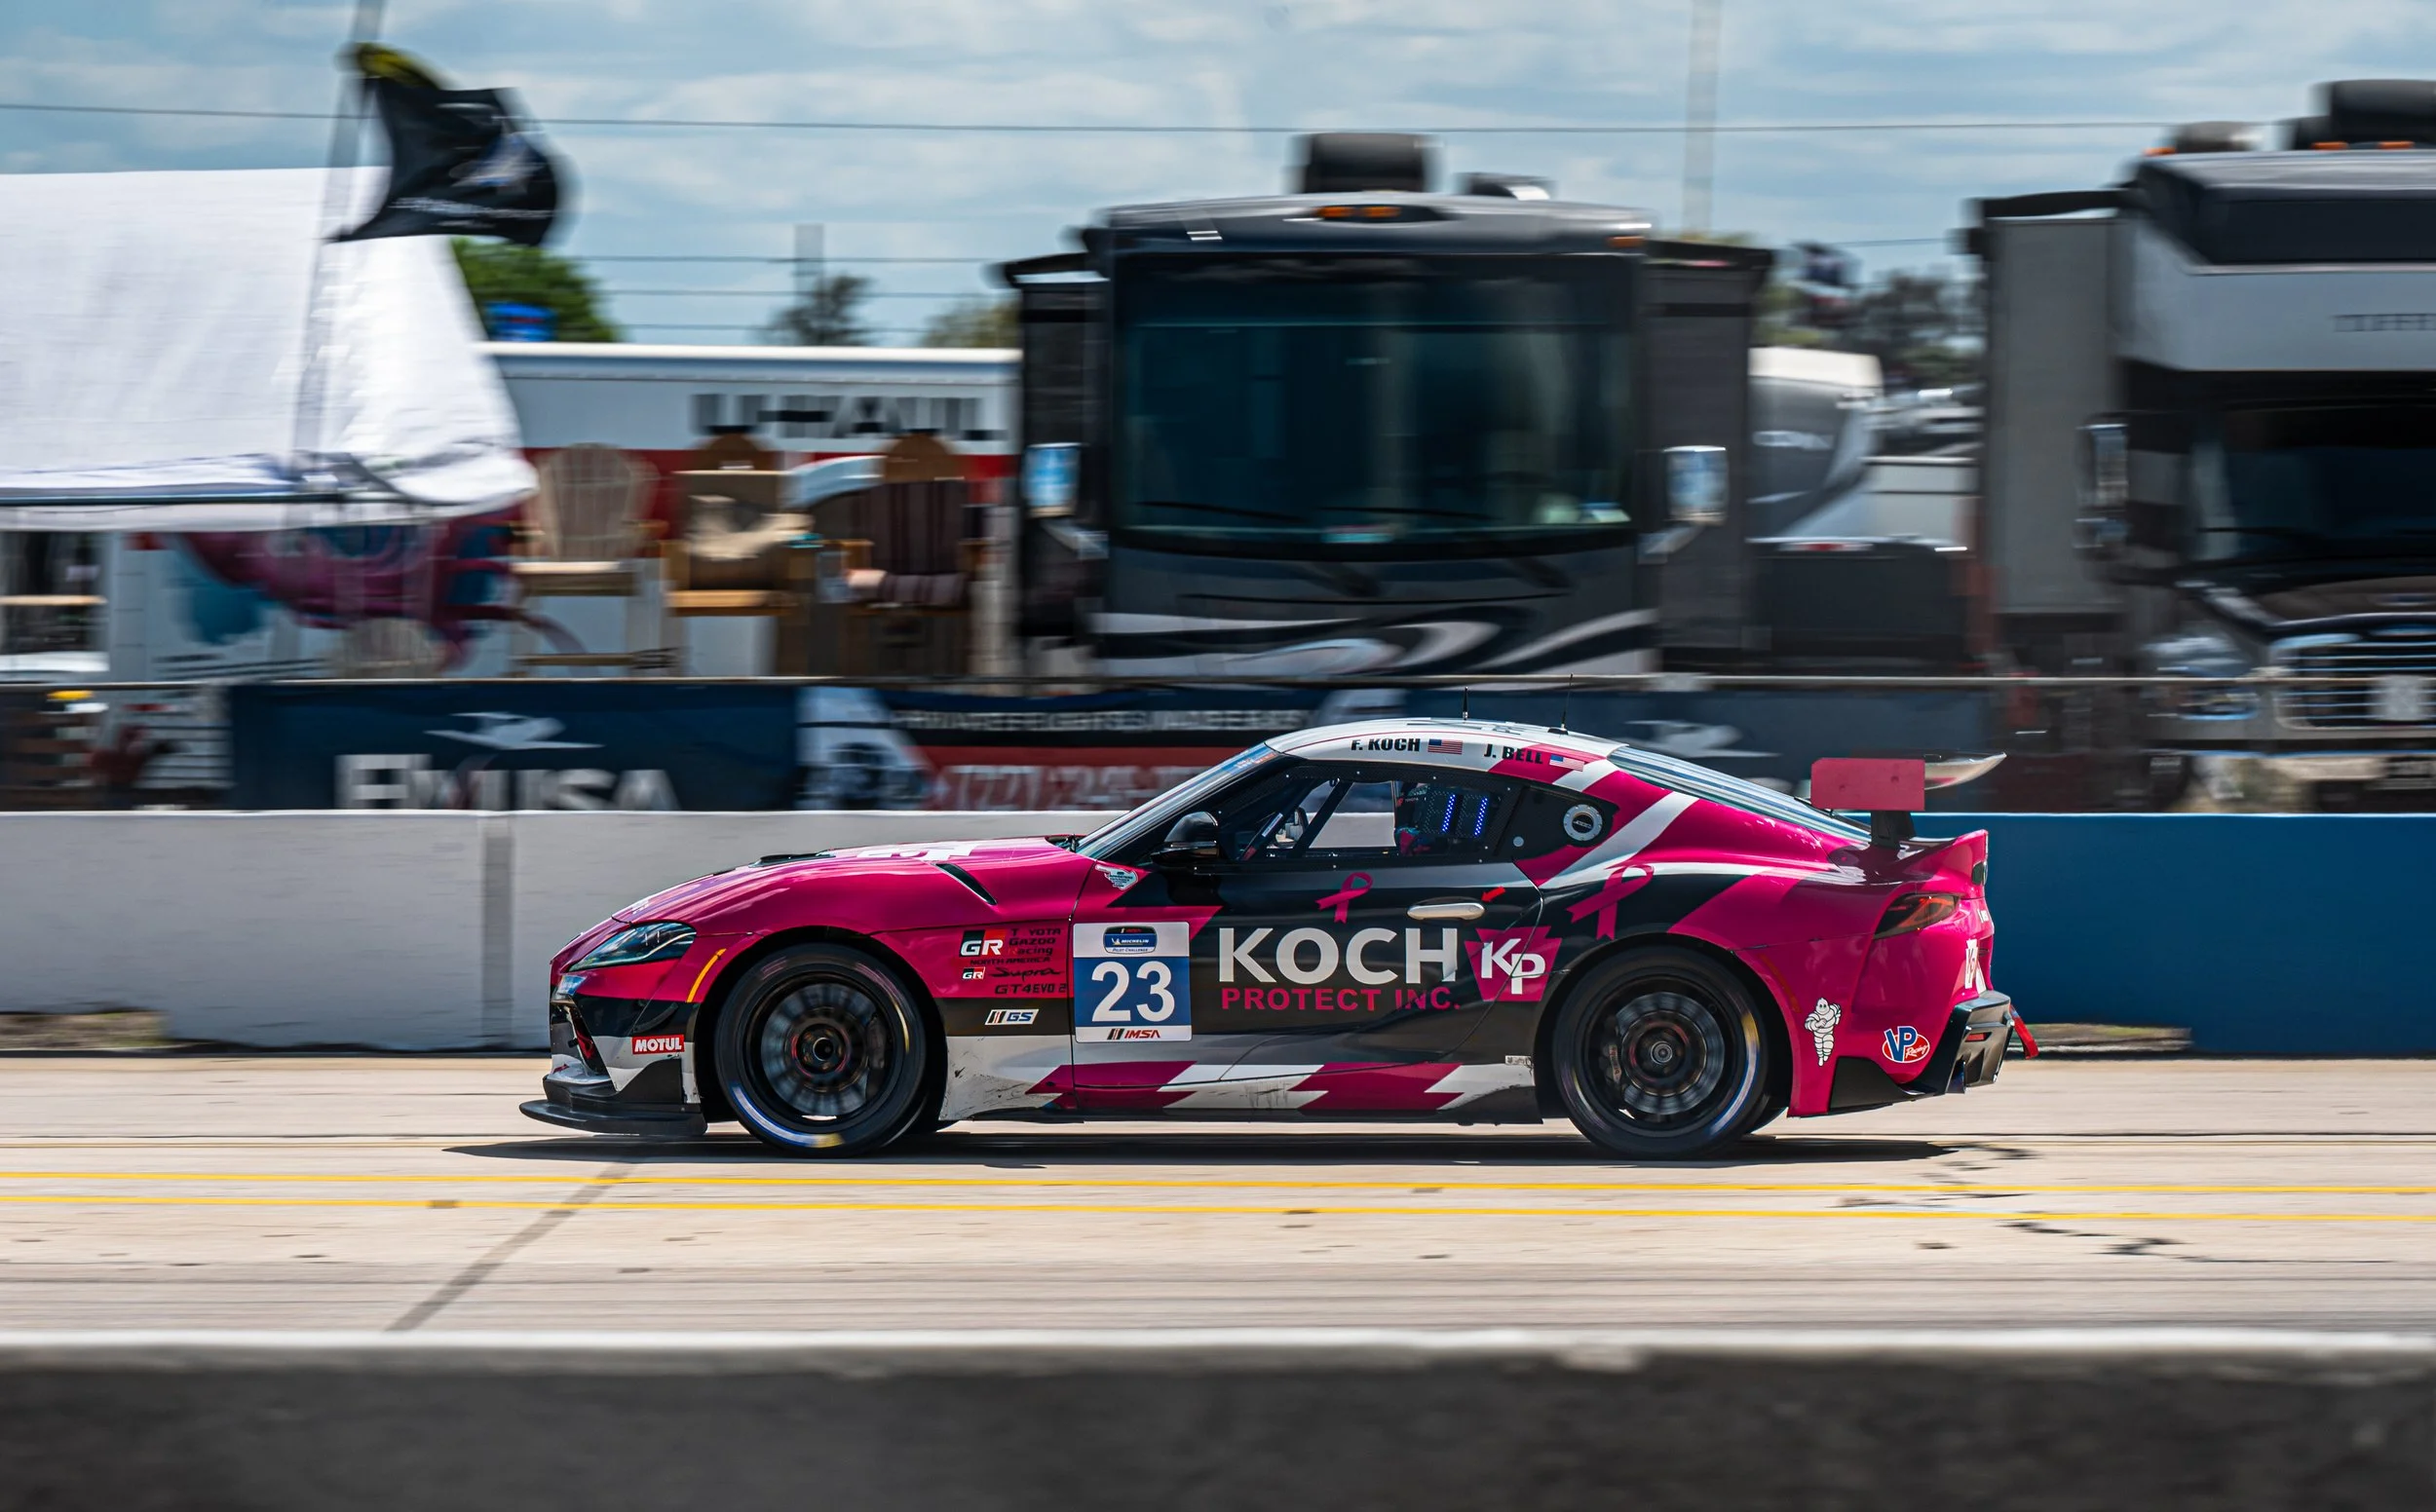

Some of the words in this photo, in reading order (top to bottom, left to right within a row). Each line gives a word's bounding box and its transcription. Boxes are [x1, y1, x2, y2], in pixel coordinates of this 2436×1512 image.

[1351, 739, 1364, 751] F.
[1368, 738, 1421, 751] KOCH
[1484, 743, 1497, 759] J.
[1502, 746, 1543, 764] BELL
[960, 939, 1004, 956] GR
[1219, 927, 1458, 985] KOCH
[962, 971, 984, 980] GR
[991, 966, 1061, 982] Supra
[1091, 961, 1175, 1022] 23
[1221, 987, 1382, 1010] PROTECT
[1394, 987, 1461, 1010] INC.
[1007, 1011, 1034, 1022] GS
[1123, 1030, 1161, 1039] IMSA
[634, 1038, 682, 1052] MOTUL
[1884, 1026, 1918, 1062] VP
